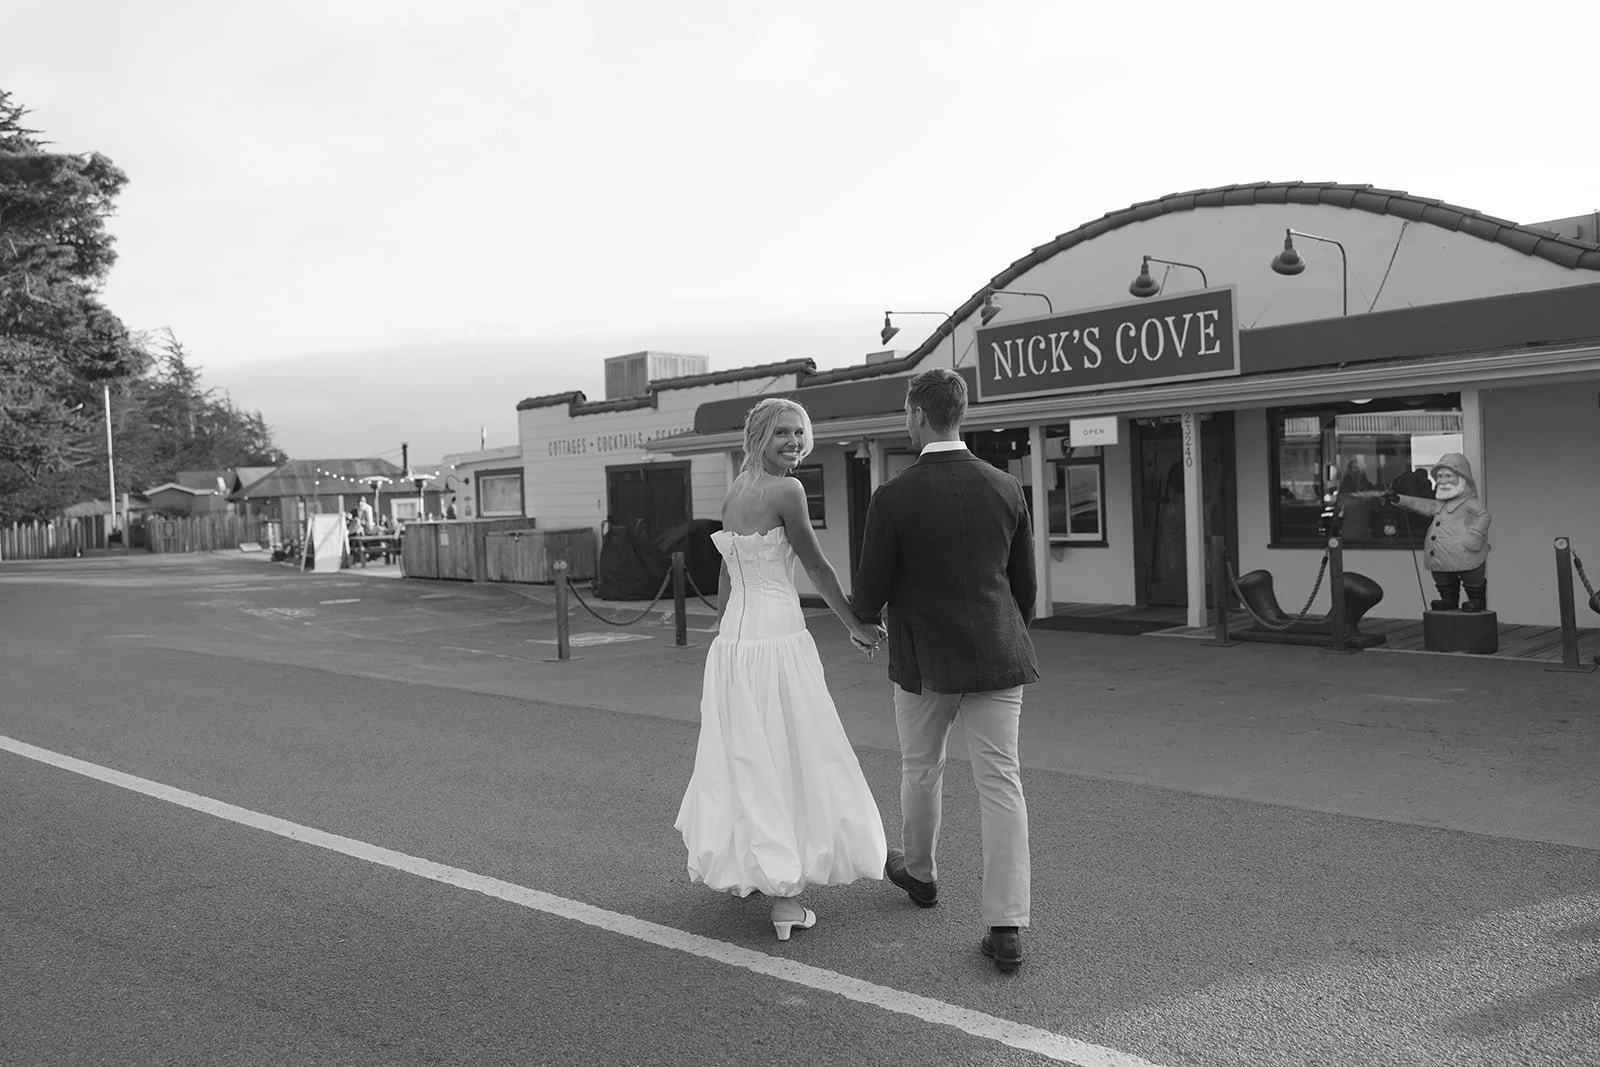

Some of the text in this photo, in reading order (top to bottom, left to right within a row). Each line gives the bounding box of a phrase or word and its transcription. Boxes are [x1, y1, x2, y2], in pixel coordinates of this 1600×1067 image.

[991, 309, 1220, 380] NICK'S COVE
[548, 438, 586, 456] COTTAGES
[597, 432, 643, 452] COCKTAILS
[1083, 428, 1104, 436] OPEN
[1184, 412, 1193, 467] 23240
